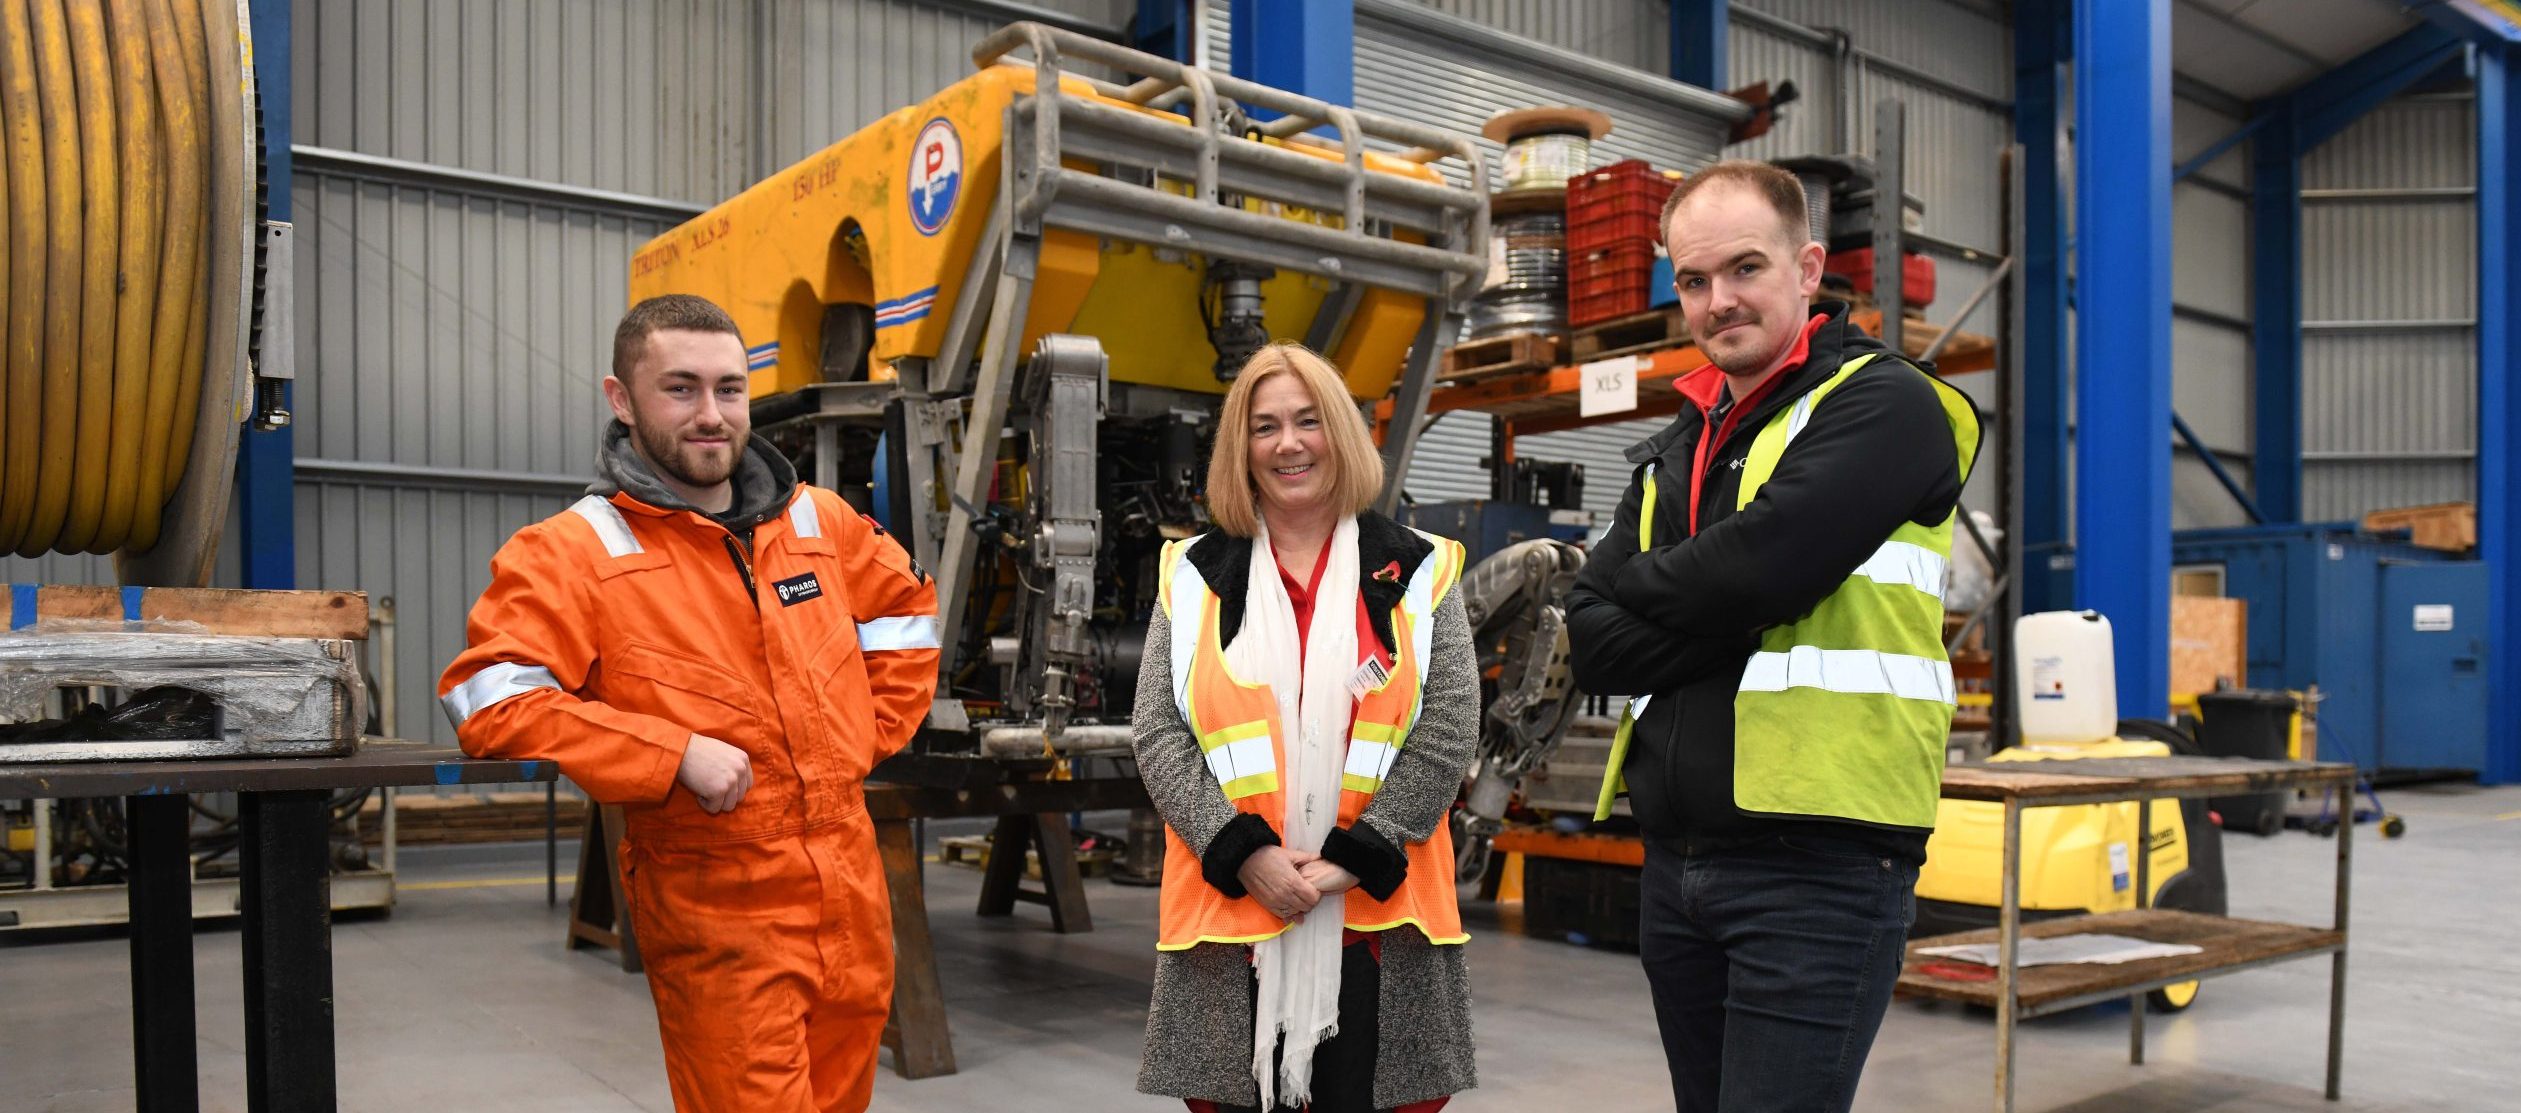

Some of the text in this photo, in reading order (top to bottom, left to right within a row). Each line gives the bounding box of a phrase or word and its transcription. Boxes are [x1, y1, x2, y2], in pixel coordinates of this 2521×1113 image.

[634, 240, 681, 278] TRITON
[1595, 372, 1624, 394] XLS
[788, 579, 818, 595] PHAROS
